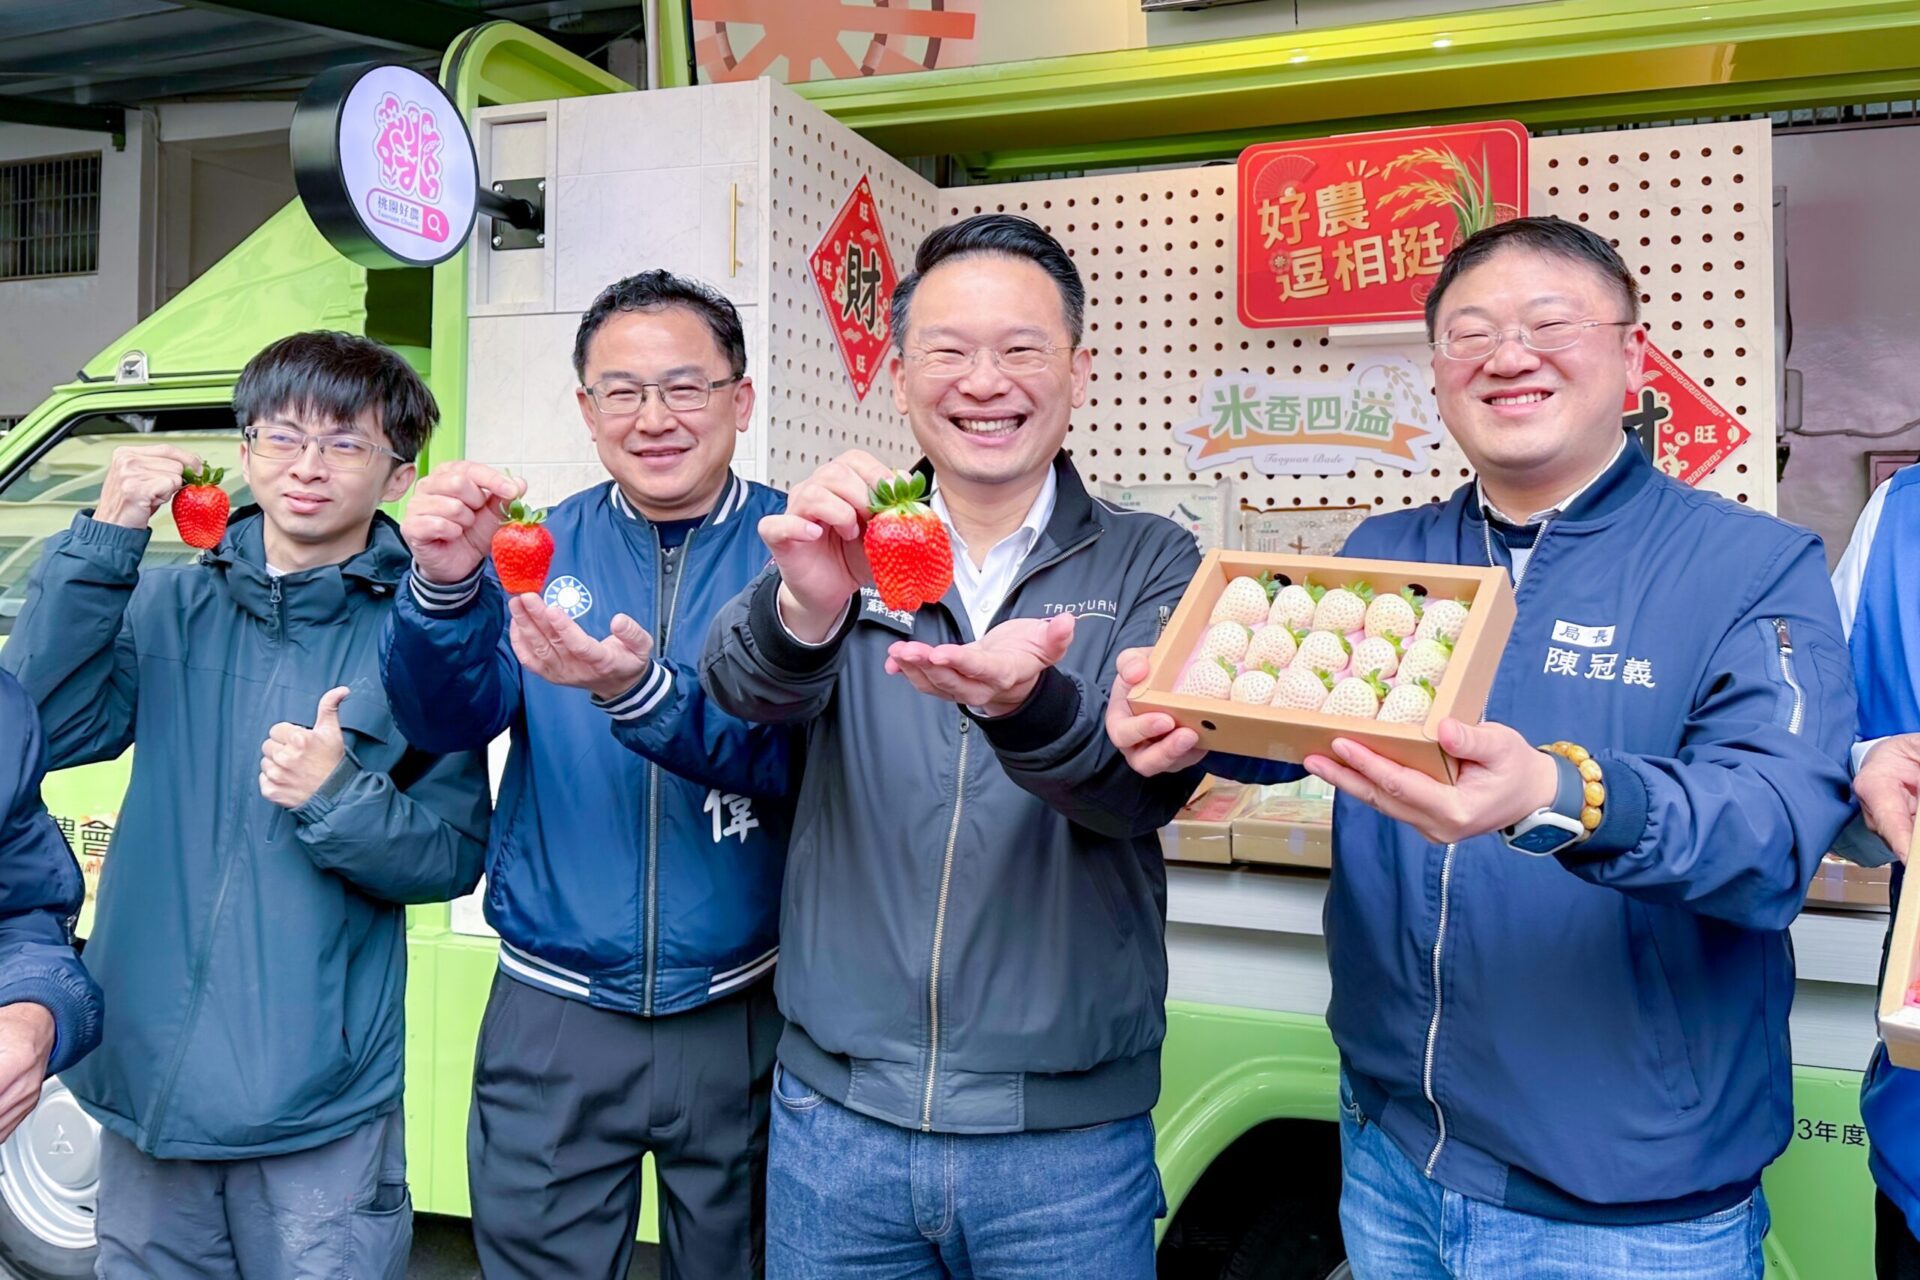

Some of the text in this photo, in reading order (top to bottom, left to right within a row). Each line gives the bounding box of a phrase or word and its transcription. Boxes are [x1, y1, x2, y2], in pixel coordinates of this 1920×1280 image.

[859, 202, 869, 222] 旺
[1257, 180, 1370, 249] 好農
[821, 259, 833, 280] 旺
[1275, 221, 1445, 302] 逗相挺
[843, 243, 881, 332] 財
[855, 354, 866, 374] 旺
[1211, 384, 1394, 437] 米香四溢
[1694, 424, 1719, 445] 旺
[1043, 599, 1118, 615] TAOYUAN
[1559, 625, 1608, 643] 局長
[1543, 646, 1656, 689] 陳冠義
[1797, 1118, 1866, 1147] 3年度
